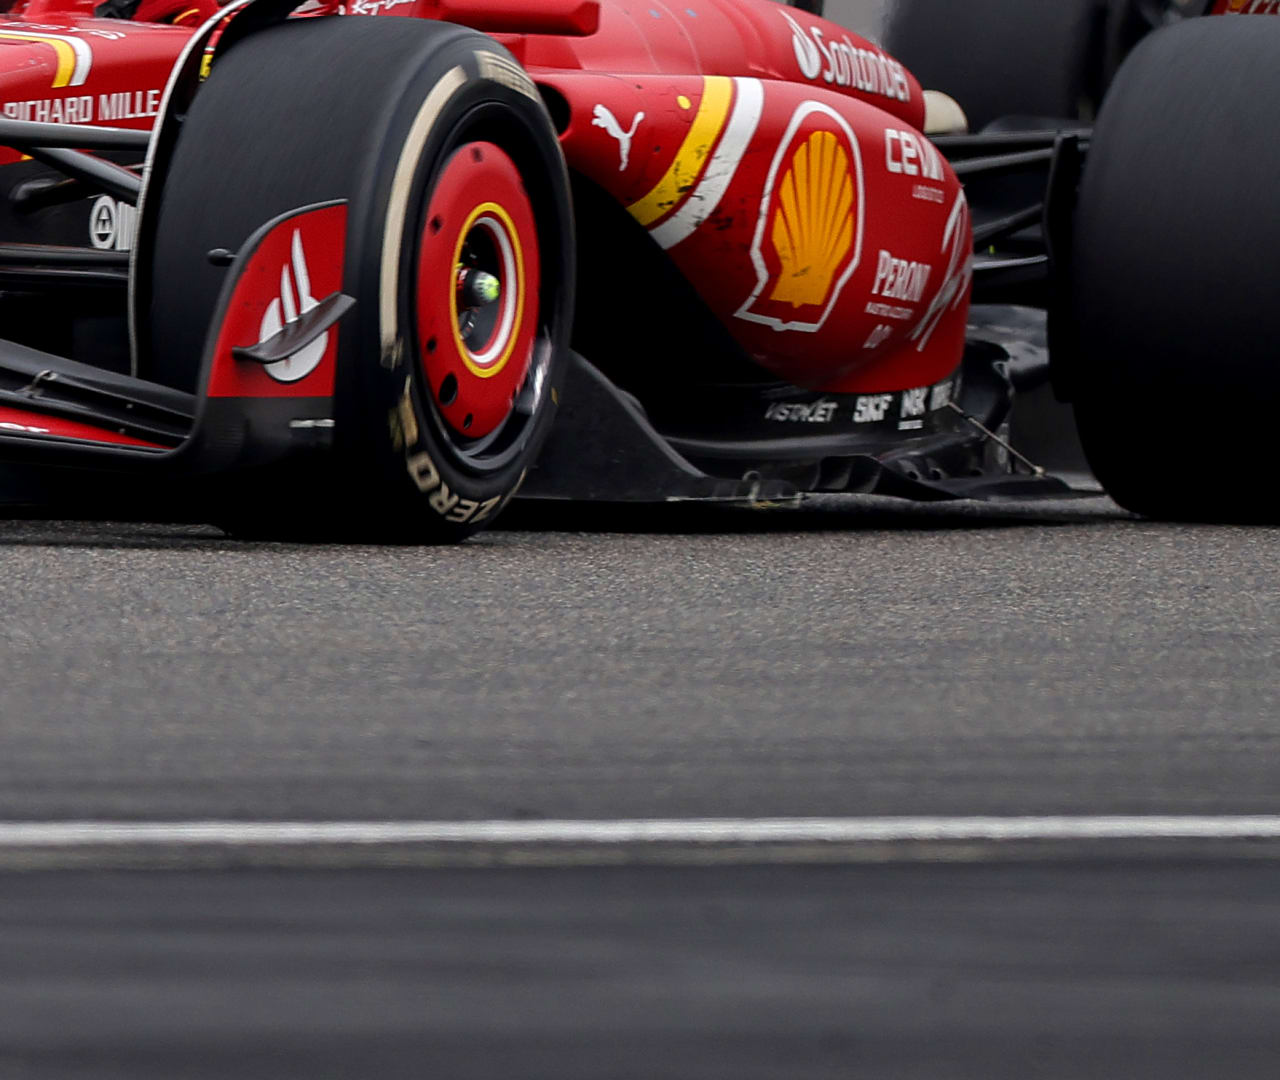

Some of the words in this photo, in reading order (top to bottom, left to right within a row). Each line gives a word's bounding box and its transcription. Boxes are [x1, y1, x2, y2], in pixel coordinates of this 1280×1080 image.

[810, 25, 911, 102] Santander
[98, 89, 160, 121] MILLE
[854, 394, 893, 423] SKF
[406, 451, 502, 524] ZERO
